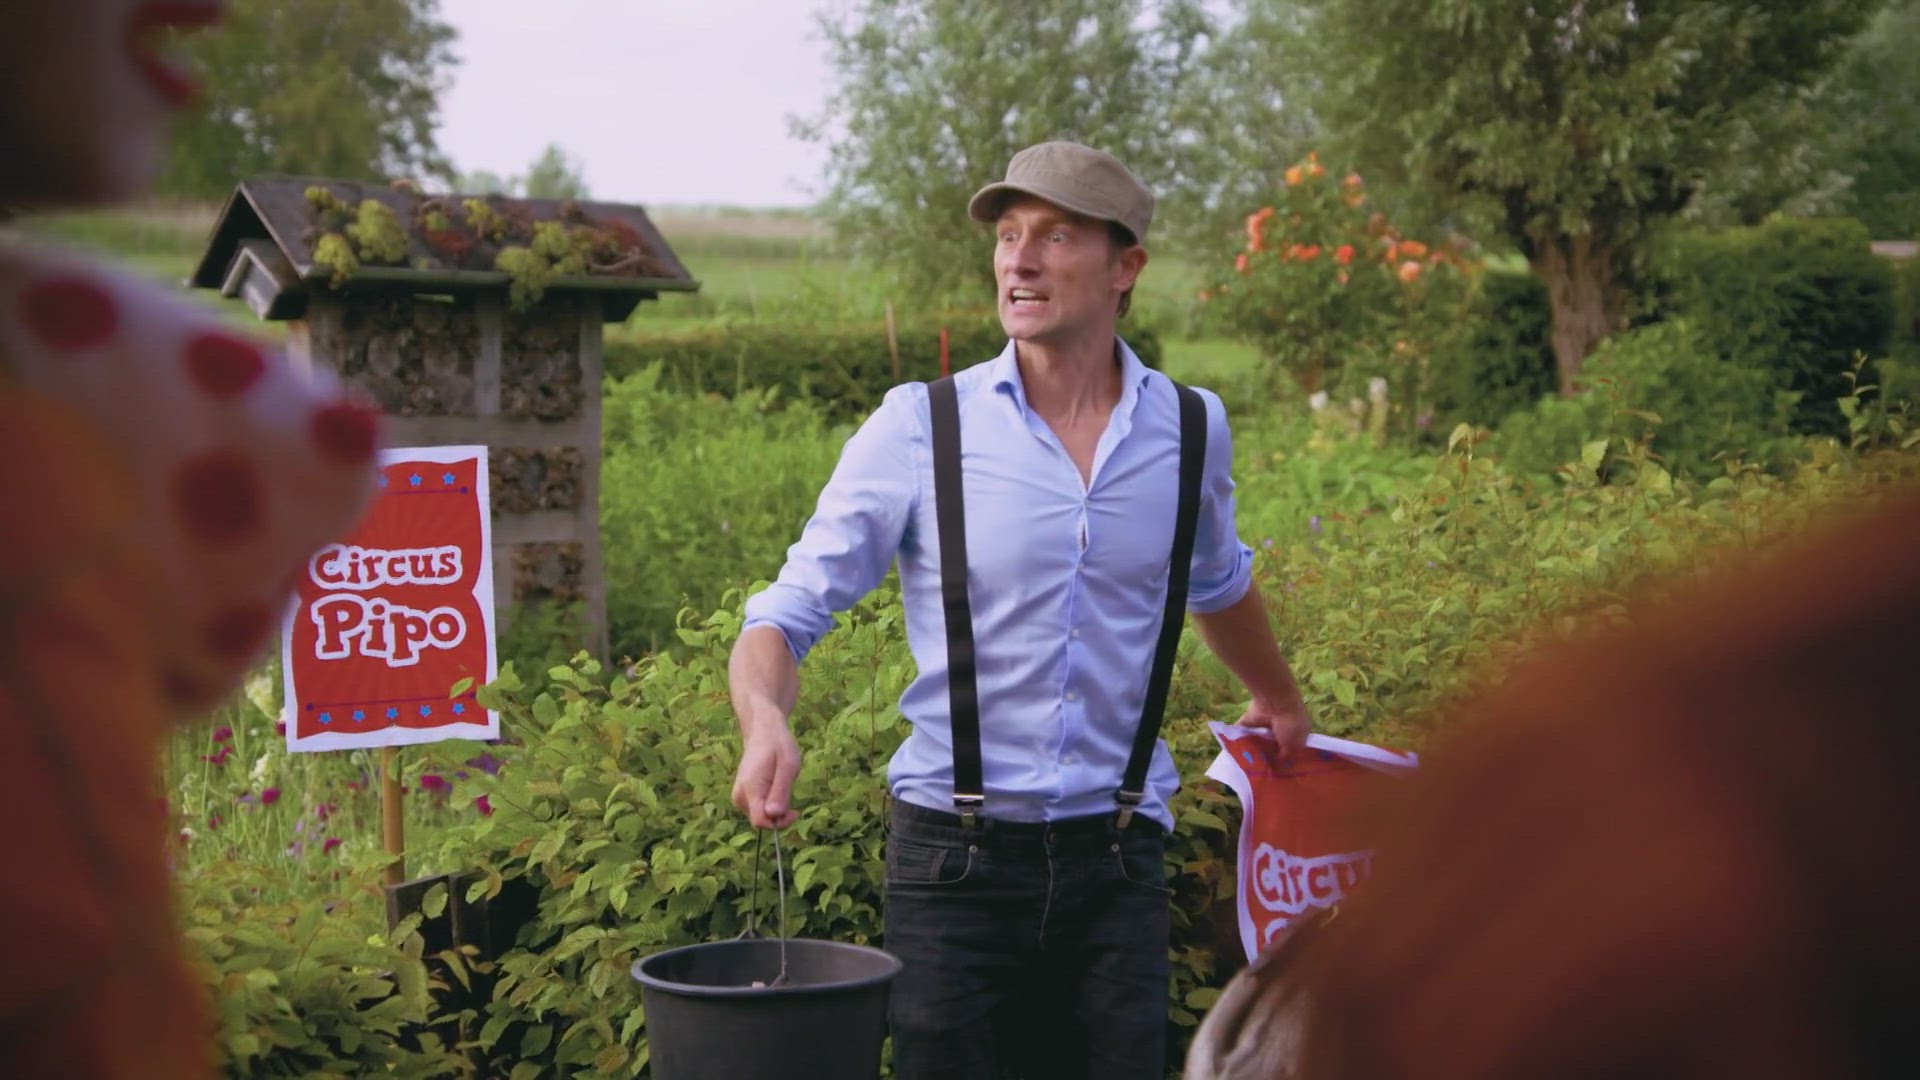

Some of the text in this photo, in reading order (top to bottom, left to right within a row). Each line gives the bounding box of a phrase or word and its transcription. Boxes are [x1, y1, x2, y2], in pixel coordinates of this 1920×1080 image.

[312, 546, 460, 587] Circus
[313, 596, 463, 664] Pipo
[1254, 846, 1372, 908] Circu
